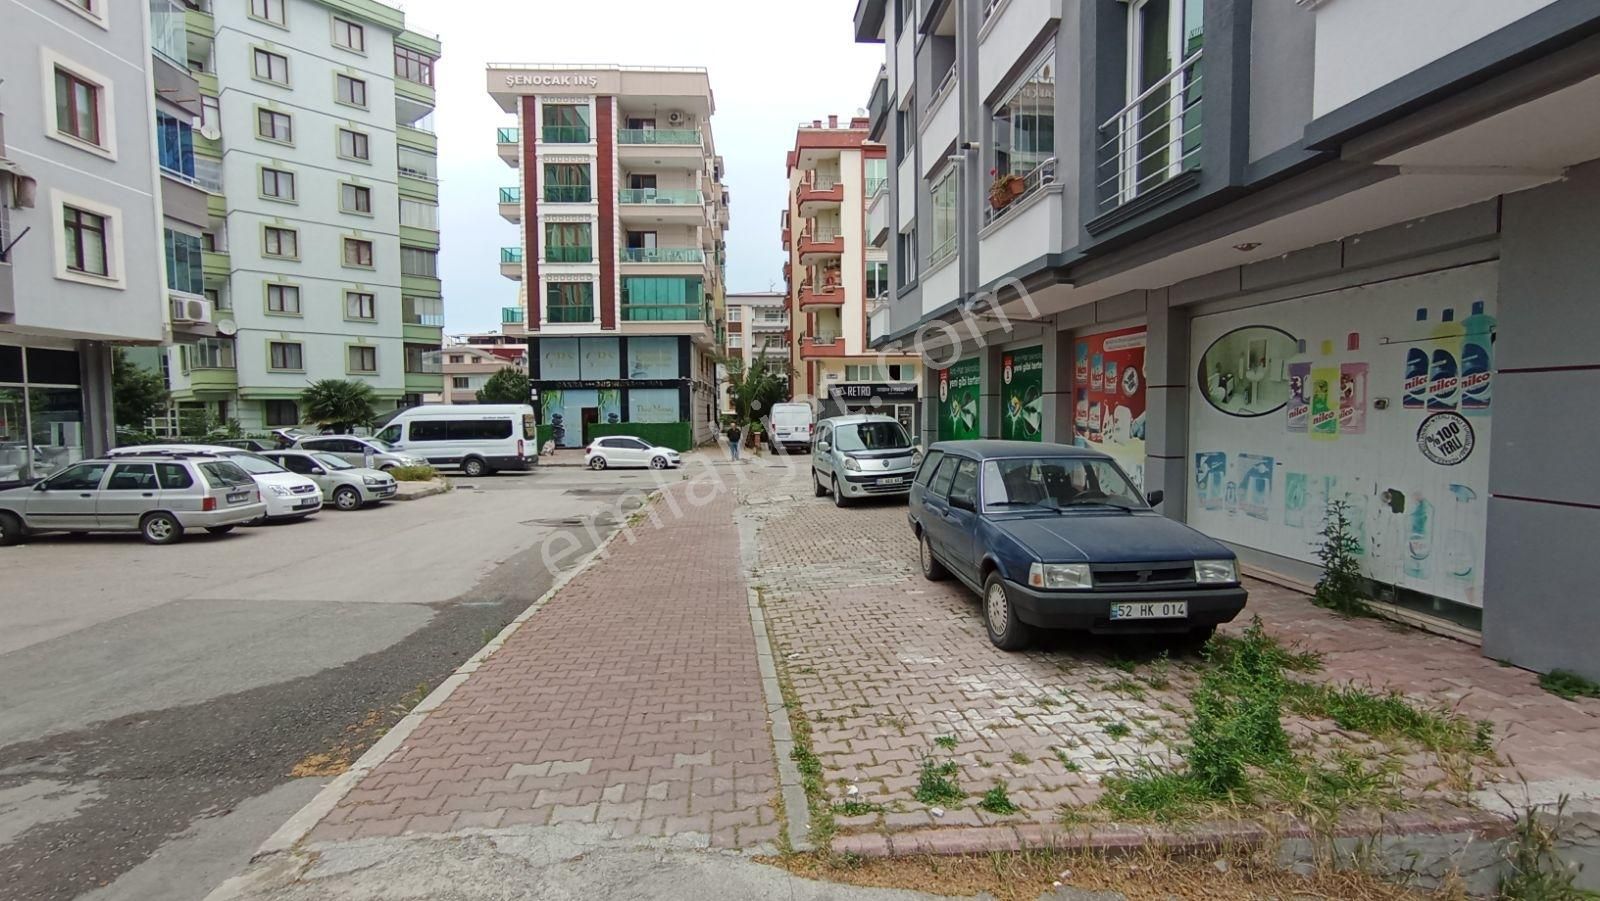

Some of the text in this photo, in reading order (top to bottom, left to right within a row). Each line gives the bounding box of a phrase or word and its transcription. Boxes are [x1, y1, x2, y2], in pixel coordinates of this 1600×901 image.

[505, 73, 598, 88] ŞENOCAK İNŞ
[1429, 378, 1458, 393] nilco
[1461, 372, 1491, 388] nilco
[847, 386, 871, 397] RETRO
[1289, 406, 1308, 419] nilco
[1313, 411, 1335, 425] nilco
[1427, 421, 1460, 448] %100
[1118, 603, 1184, 617] 52 HK 014
